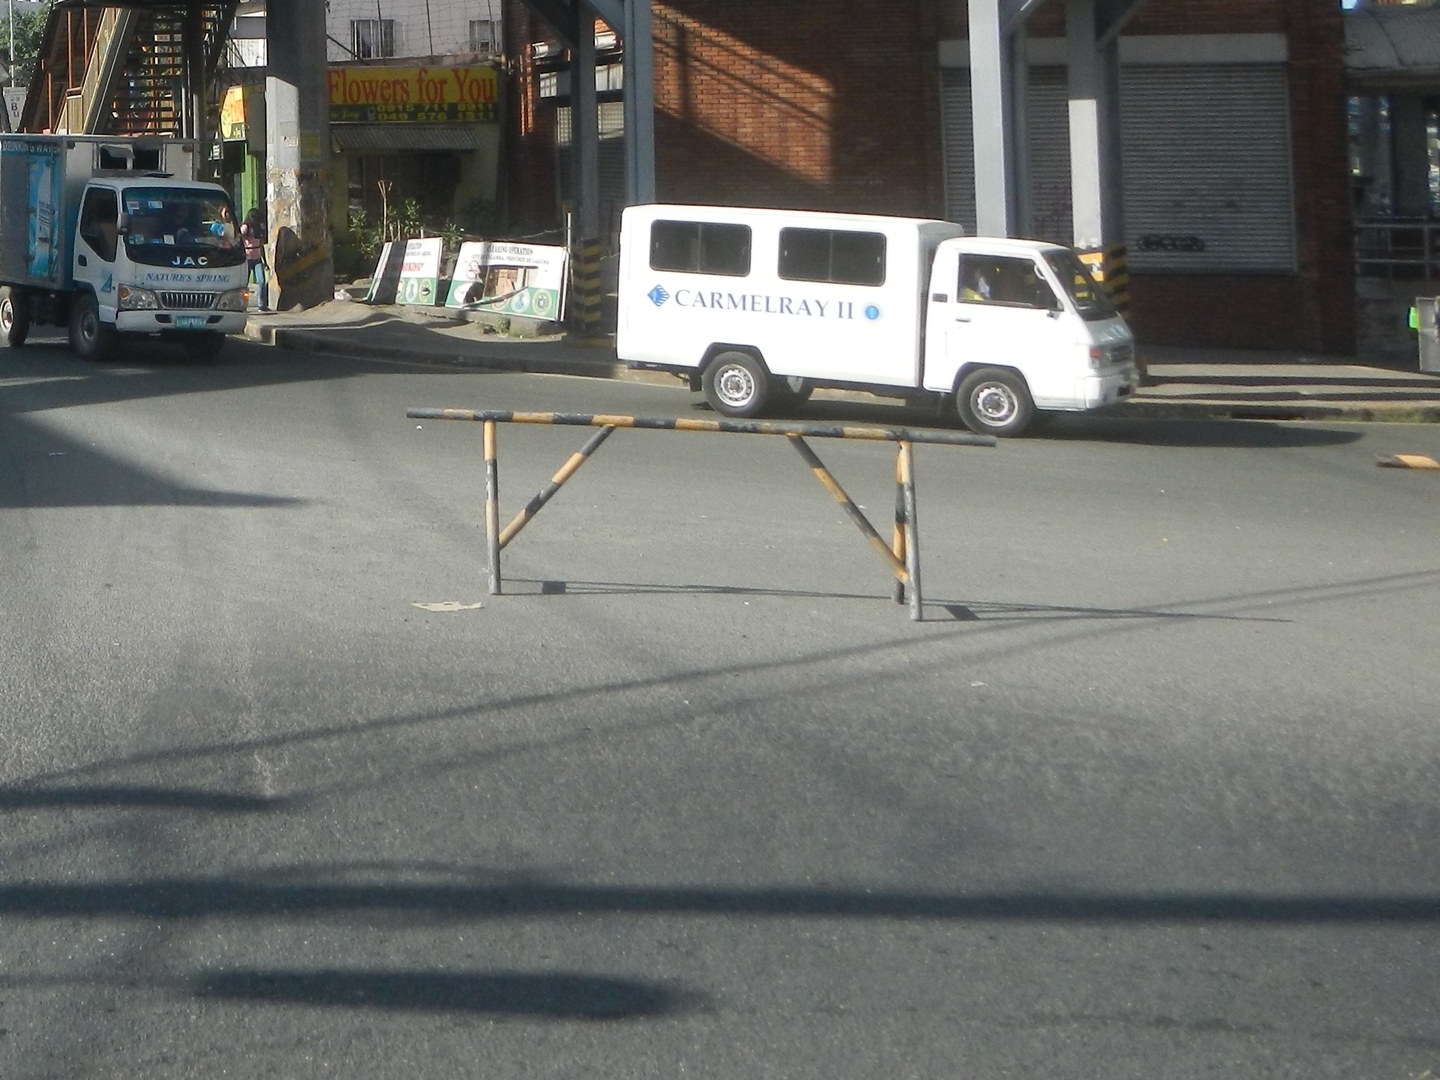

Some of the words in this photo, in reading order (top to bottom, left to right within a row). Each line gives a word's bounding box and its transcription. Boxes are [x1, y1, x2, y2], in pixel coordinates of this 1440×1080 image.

[328, 70, 410, 104] Flowers
[418, 68, 448, 104] for
[451, 69, 494, 104] You
[171, 256, 208, 266] JAC
[146, 273, 192, 282] NATURE'S
[196, 274, 230, 283] SPRING
[674, 289, 831, 318] CARMELRAY
[837, 301, 854, 319] II
